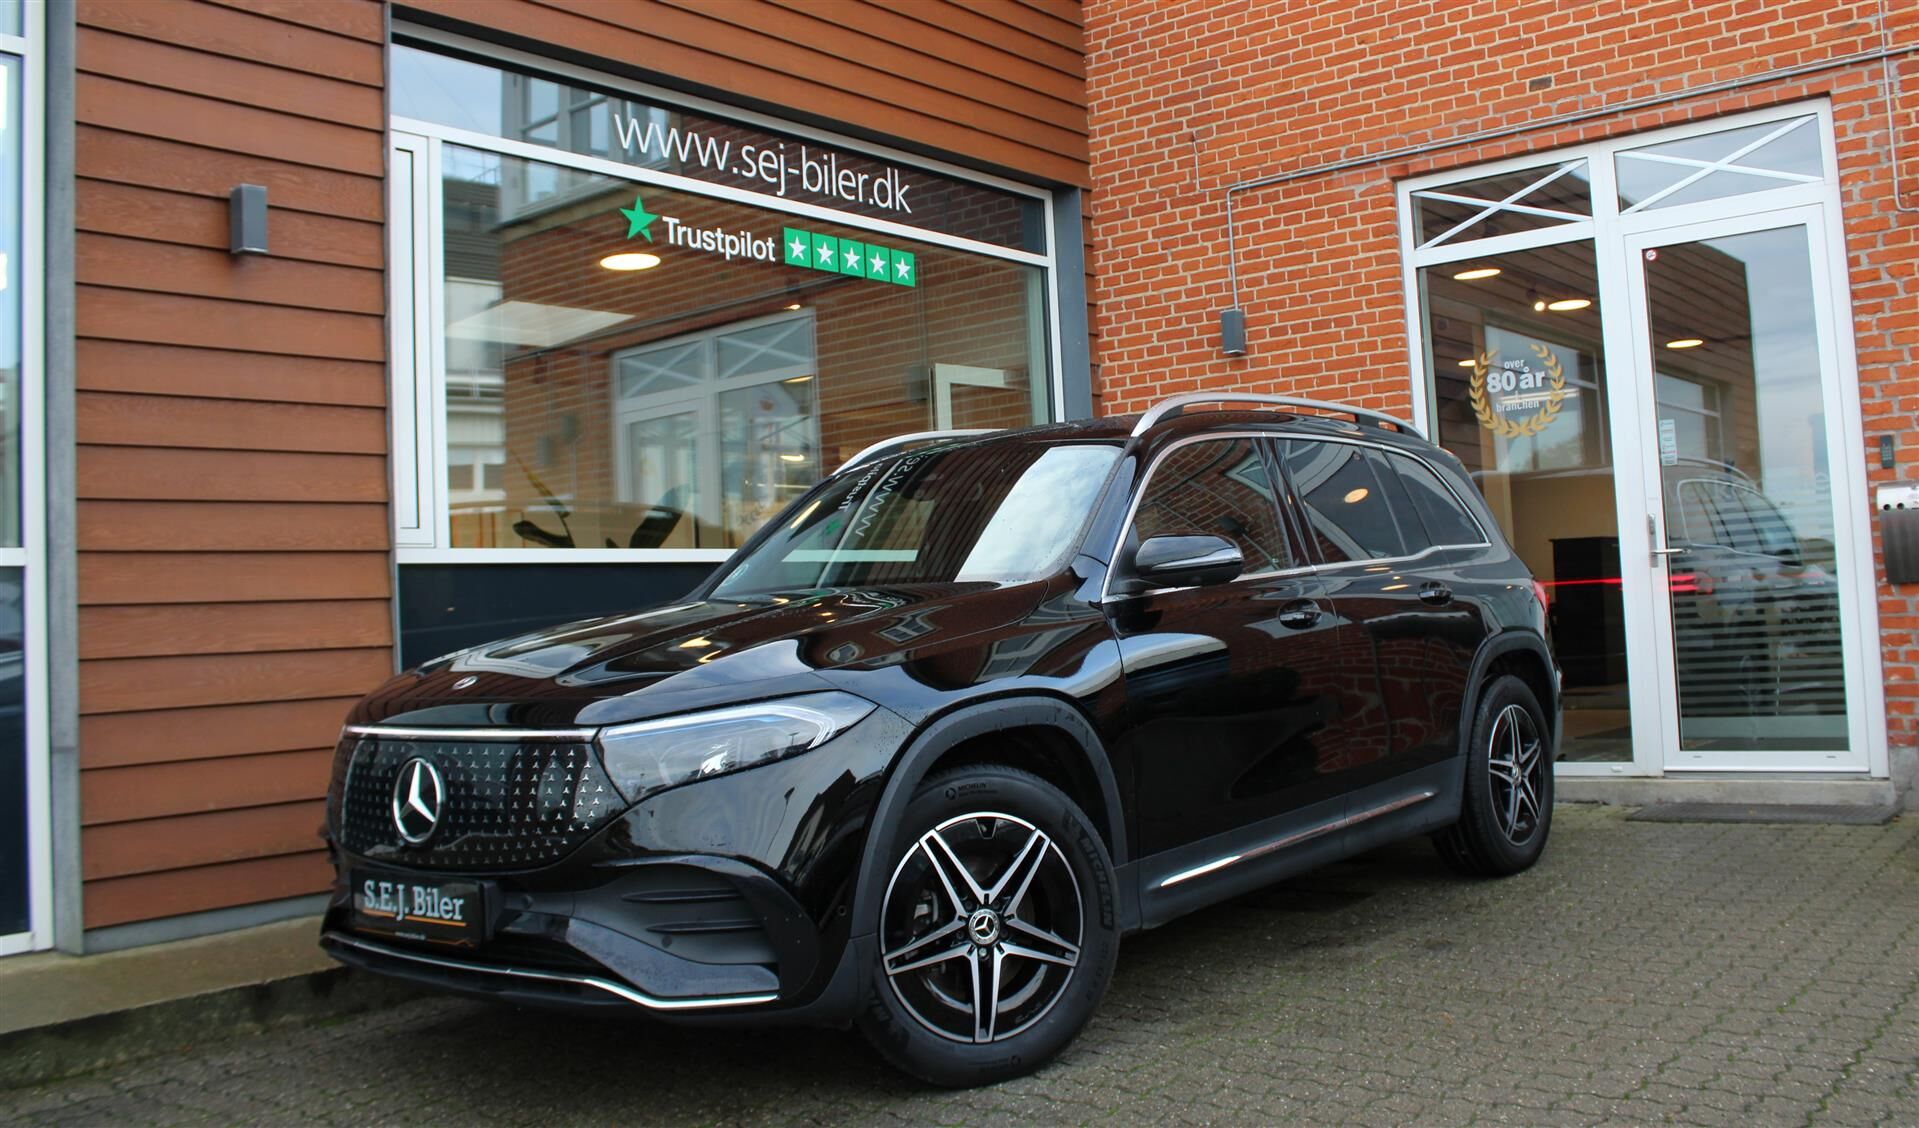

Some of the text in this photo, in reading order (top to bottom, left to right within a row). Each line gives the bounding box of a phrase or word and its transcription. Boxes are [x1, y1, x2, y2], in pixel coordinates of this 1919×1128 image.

[614, 113, 912, 214] www.sej-biler.dk
[662, 216, 776, 262] Trustpilot
[1486, 367, 1545, 393] 80 år
[1504, 360, 1525, 369] over
[1495, 400, 1540, 412] branchen
[363, 879, 465, 921] S.E.J. Biler
